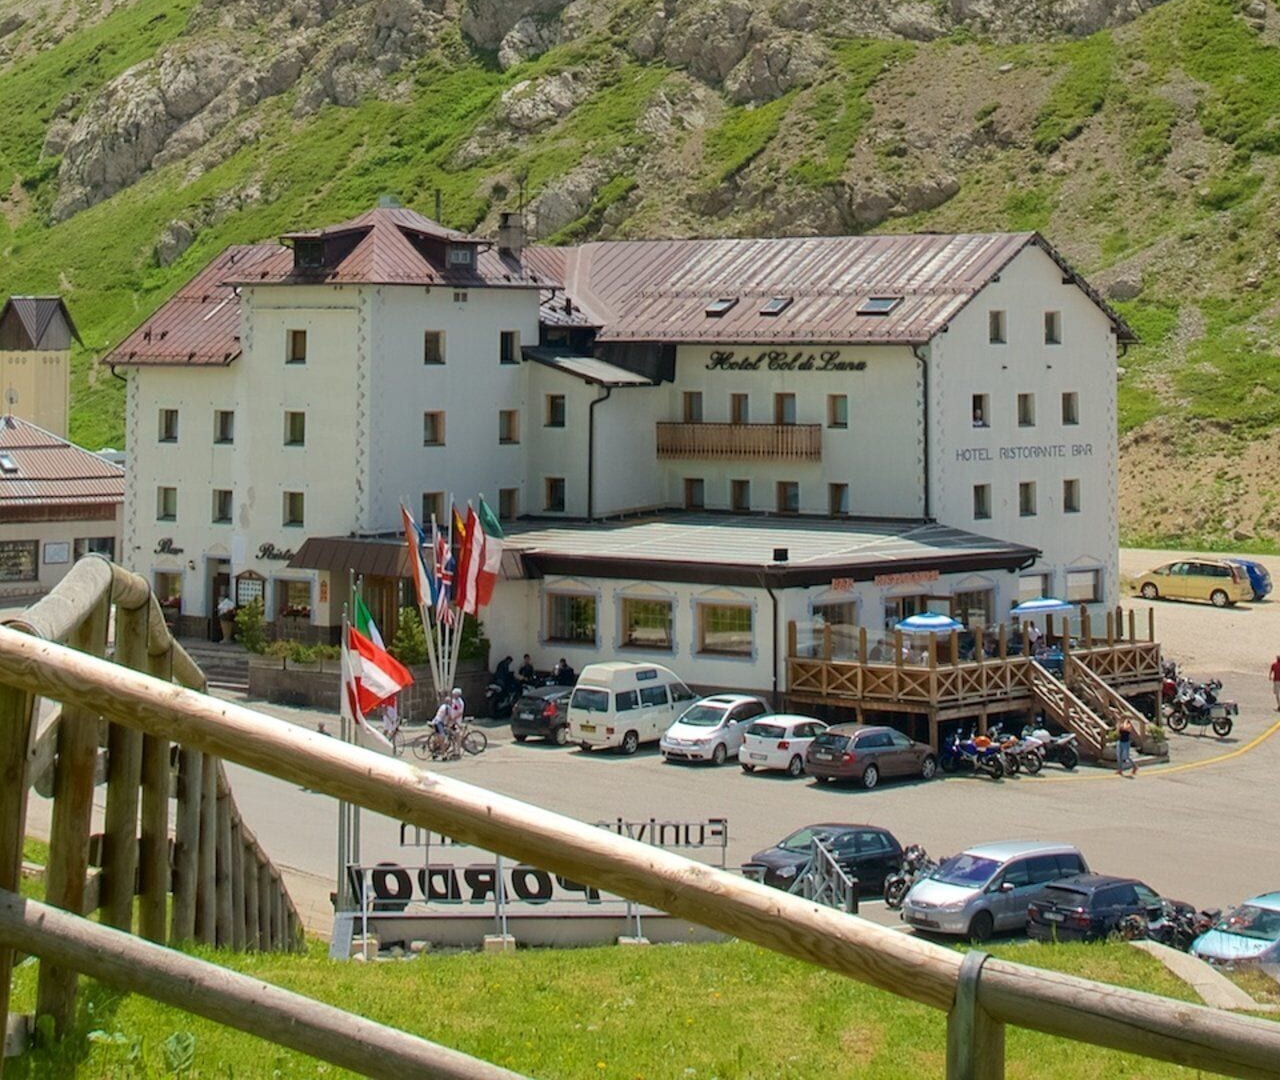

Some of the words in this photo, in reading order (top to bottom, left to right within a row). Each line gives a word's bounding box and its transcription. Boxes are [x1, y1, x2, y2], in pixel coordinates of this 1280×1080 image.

[705, 350, 767, 370] Hotel
[767, 350, 803, 370] Col
[797, 353, 816, 370] di
[955, 448, 993, 461] HOTEL
[999, 444, 1066, 459] RISTORANTE
[1071, 443, 1093, 456] BAR
[154, 538, 183, 555] Bar
